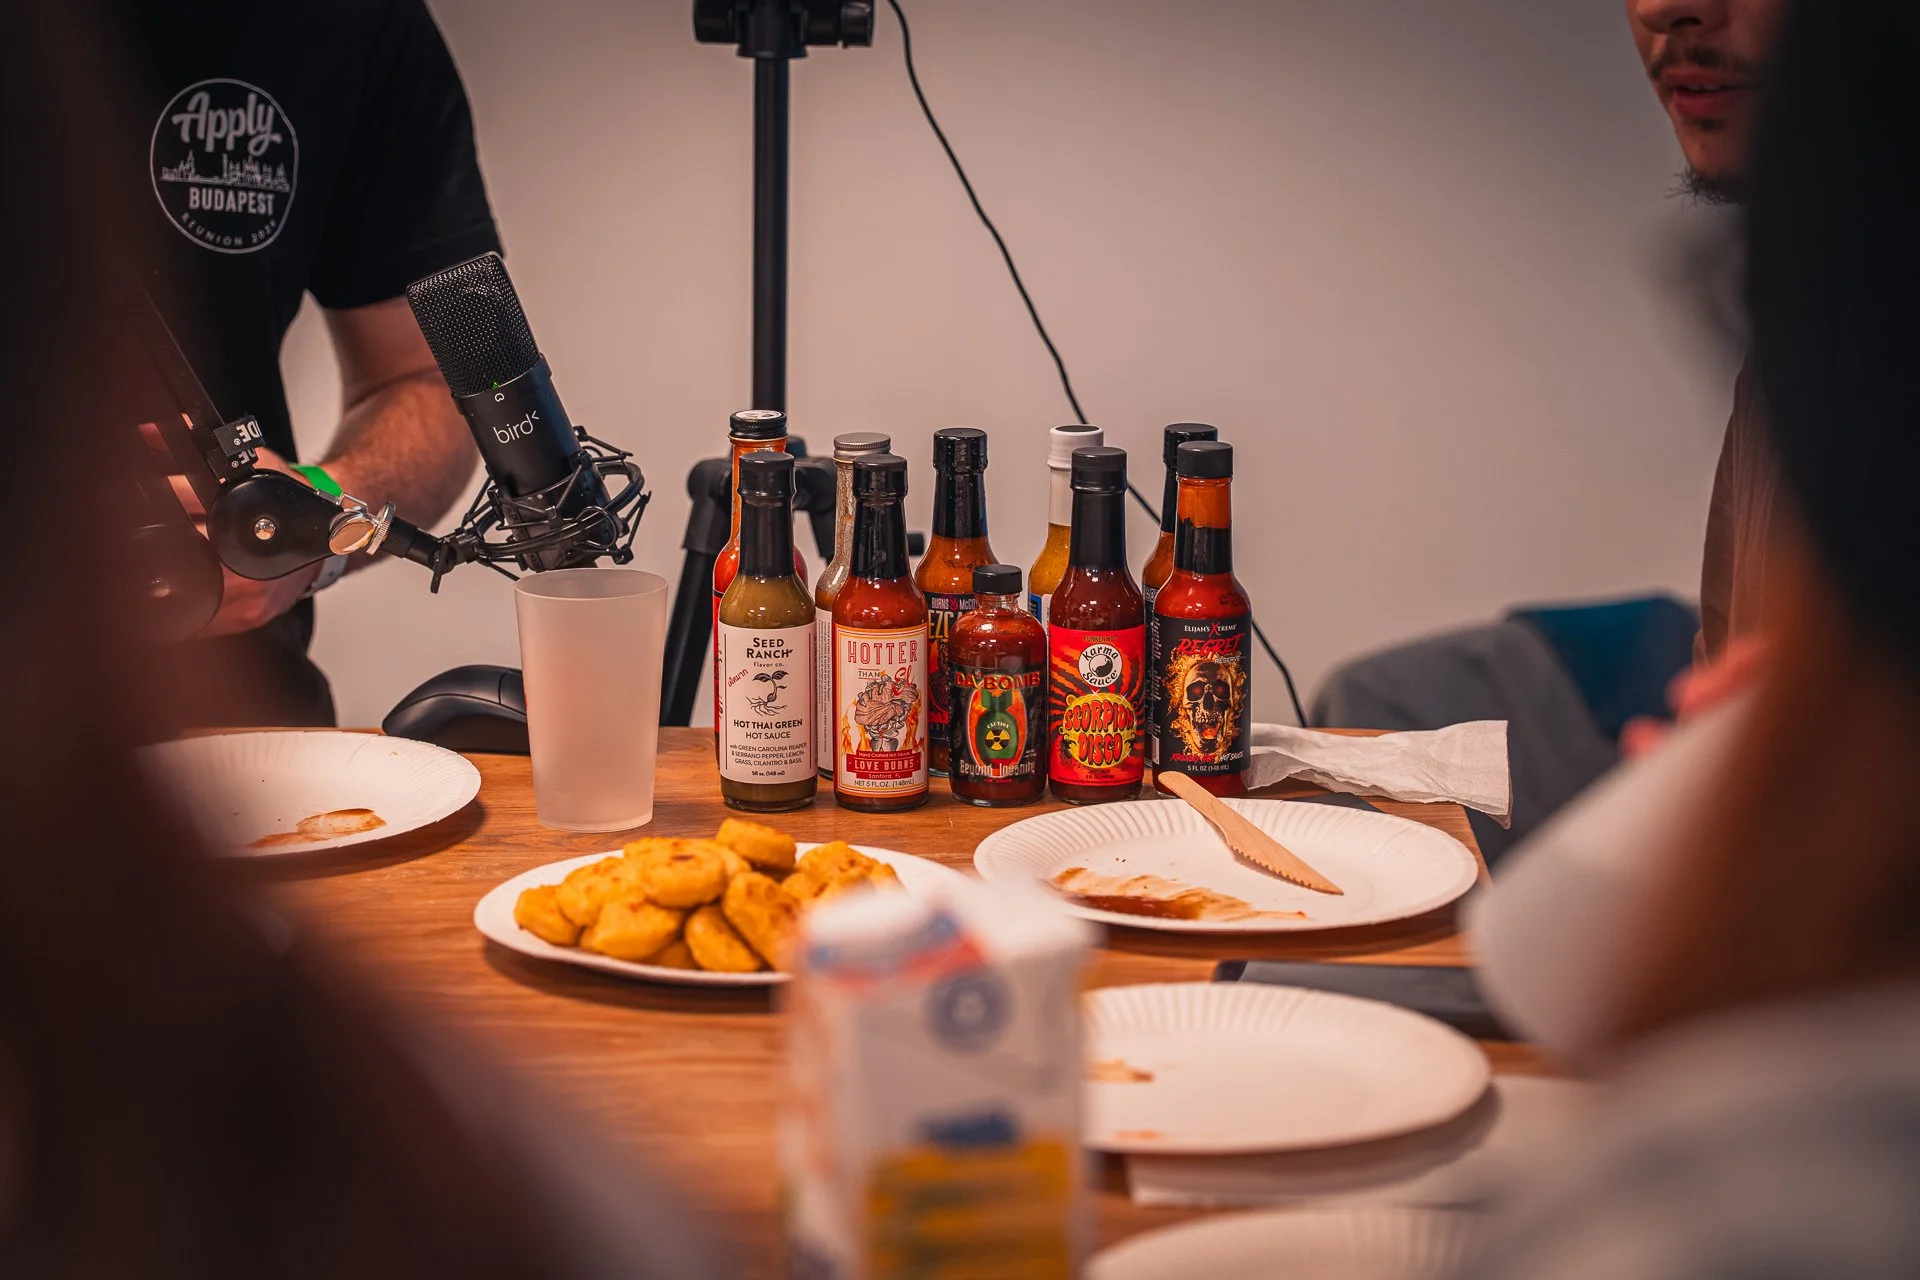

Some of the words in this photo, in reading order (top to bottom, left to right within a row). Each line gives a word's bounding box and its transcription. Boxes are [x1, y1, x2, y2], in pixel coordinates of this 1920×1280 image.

[171, 90, 283, 156] Apply
[188, 186, 275, 216] BUDAPEST
[181, 212, 244, 246] REUNION
[493, 415, 534, 444] bird
[931, 597, 950, 610] BURNS
[959, 598, 977, 610] McCO
[1184, 624, 1210, 633] ELIJAH'S
[753, 637, 785, 648] SEED
[1177, 633, 1246, 657] REGRET
[746, 648, 790, 659] RANCH
[847, 640, 918, 665] HOTTER
[1082, 646, 1119, 661] Karma
[753, 660, 773, 668] flavor
[1214, 655, 1240, 664] RESERVE
[858, 670, 881, 679] THAN
[1083, 672, 1118, 686] Sauce
[1065, 700, 1135, 733] SCORPION
[733, 719, 751, 729] HOT
[752, 721, 773, 730] THAI
[775, 718, 803, 729] GREEN
[745, 732, 764, 740] HOT
[765, 731, 791, 740] SAUCE
[738, 744, 756, 752] GREEN
[788, 742, 807, 750] REAPER
[1077, 732, 1123, 765] DISCO
[735, 751, 761, 759] SERRANO
[735, 758, 753, 766] GRASS,
[854, 759, 879, 770] LOVE
[884, 758, 914, 771] BURNS
[960, 759, 993, 776] Beyond
[854, 779, 865, 787] NET
